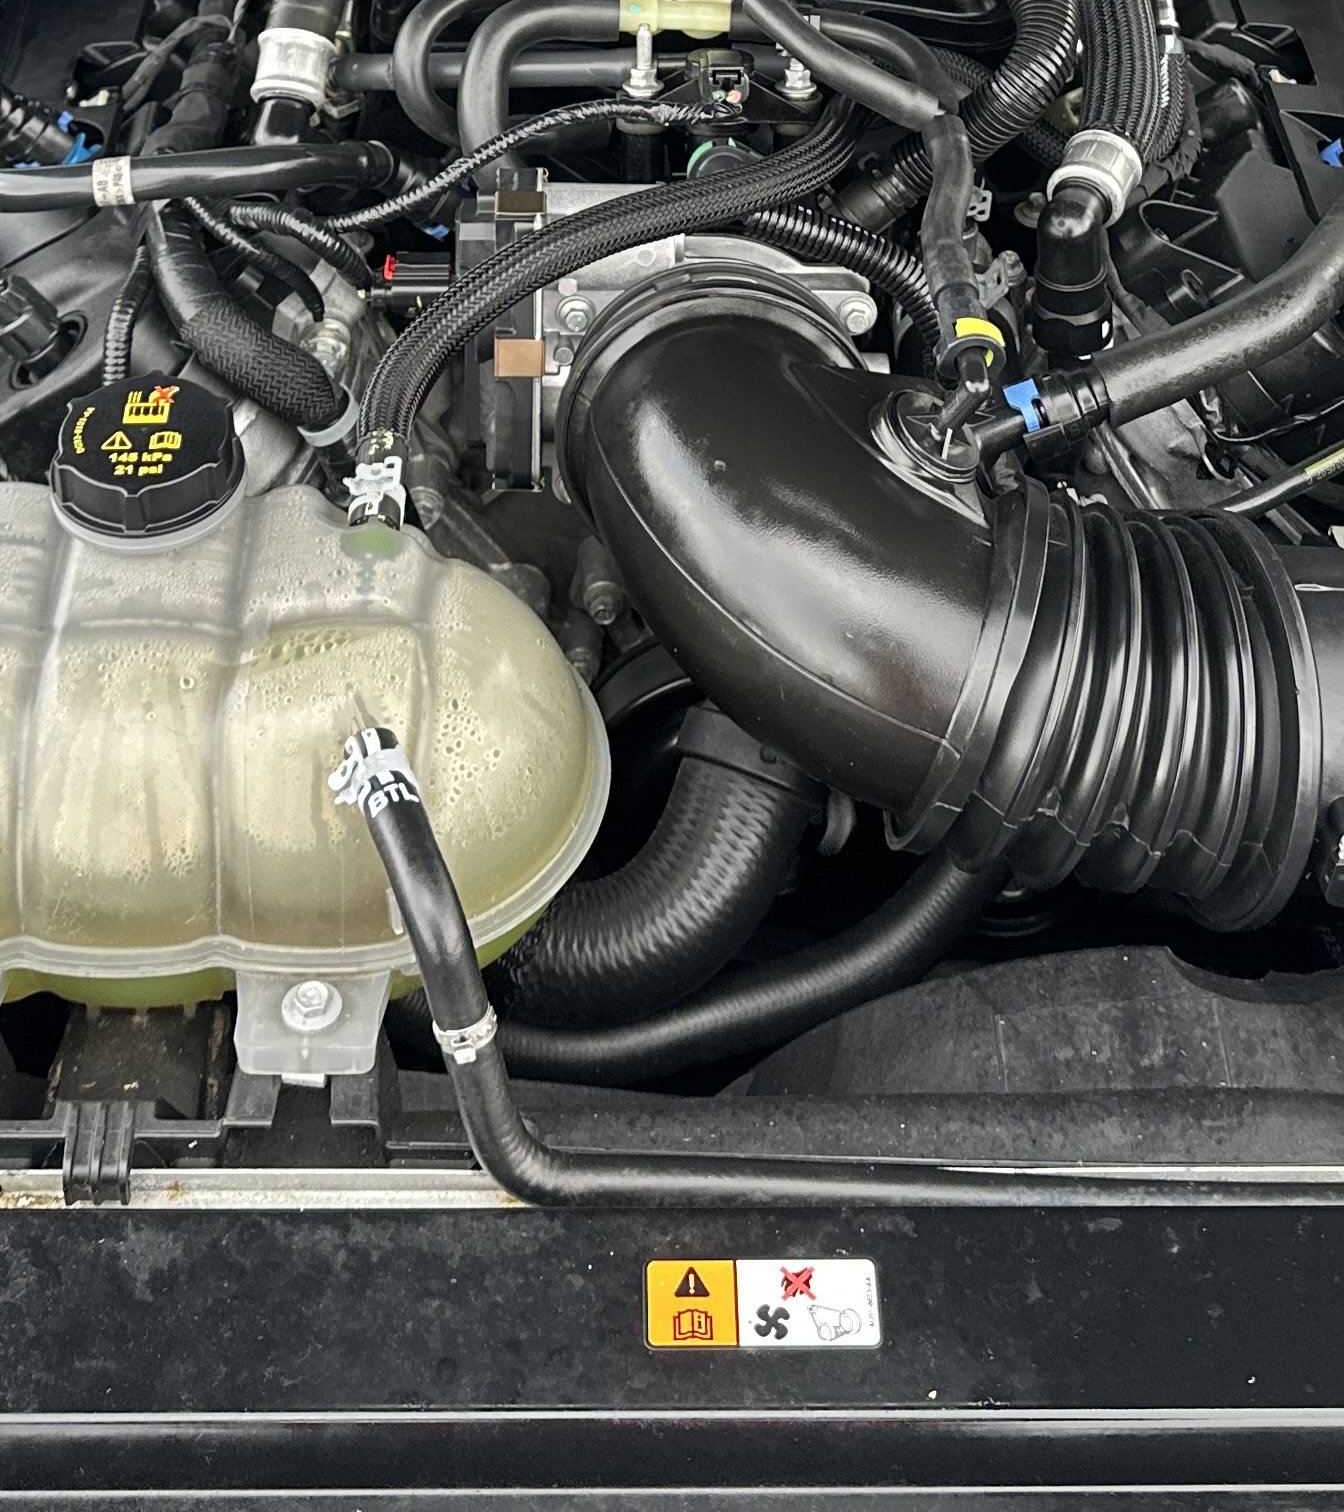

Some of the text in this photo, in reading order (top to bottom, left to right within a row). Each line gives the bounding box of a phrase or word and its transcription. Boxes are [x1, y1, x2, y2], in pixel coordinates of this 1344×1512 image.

[108, 452, 173, 463] 145 kPa
[113, 463, 164, 477] 21 psi
[367, 781, 420, 818] BTL
